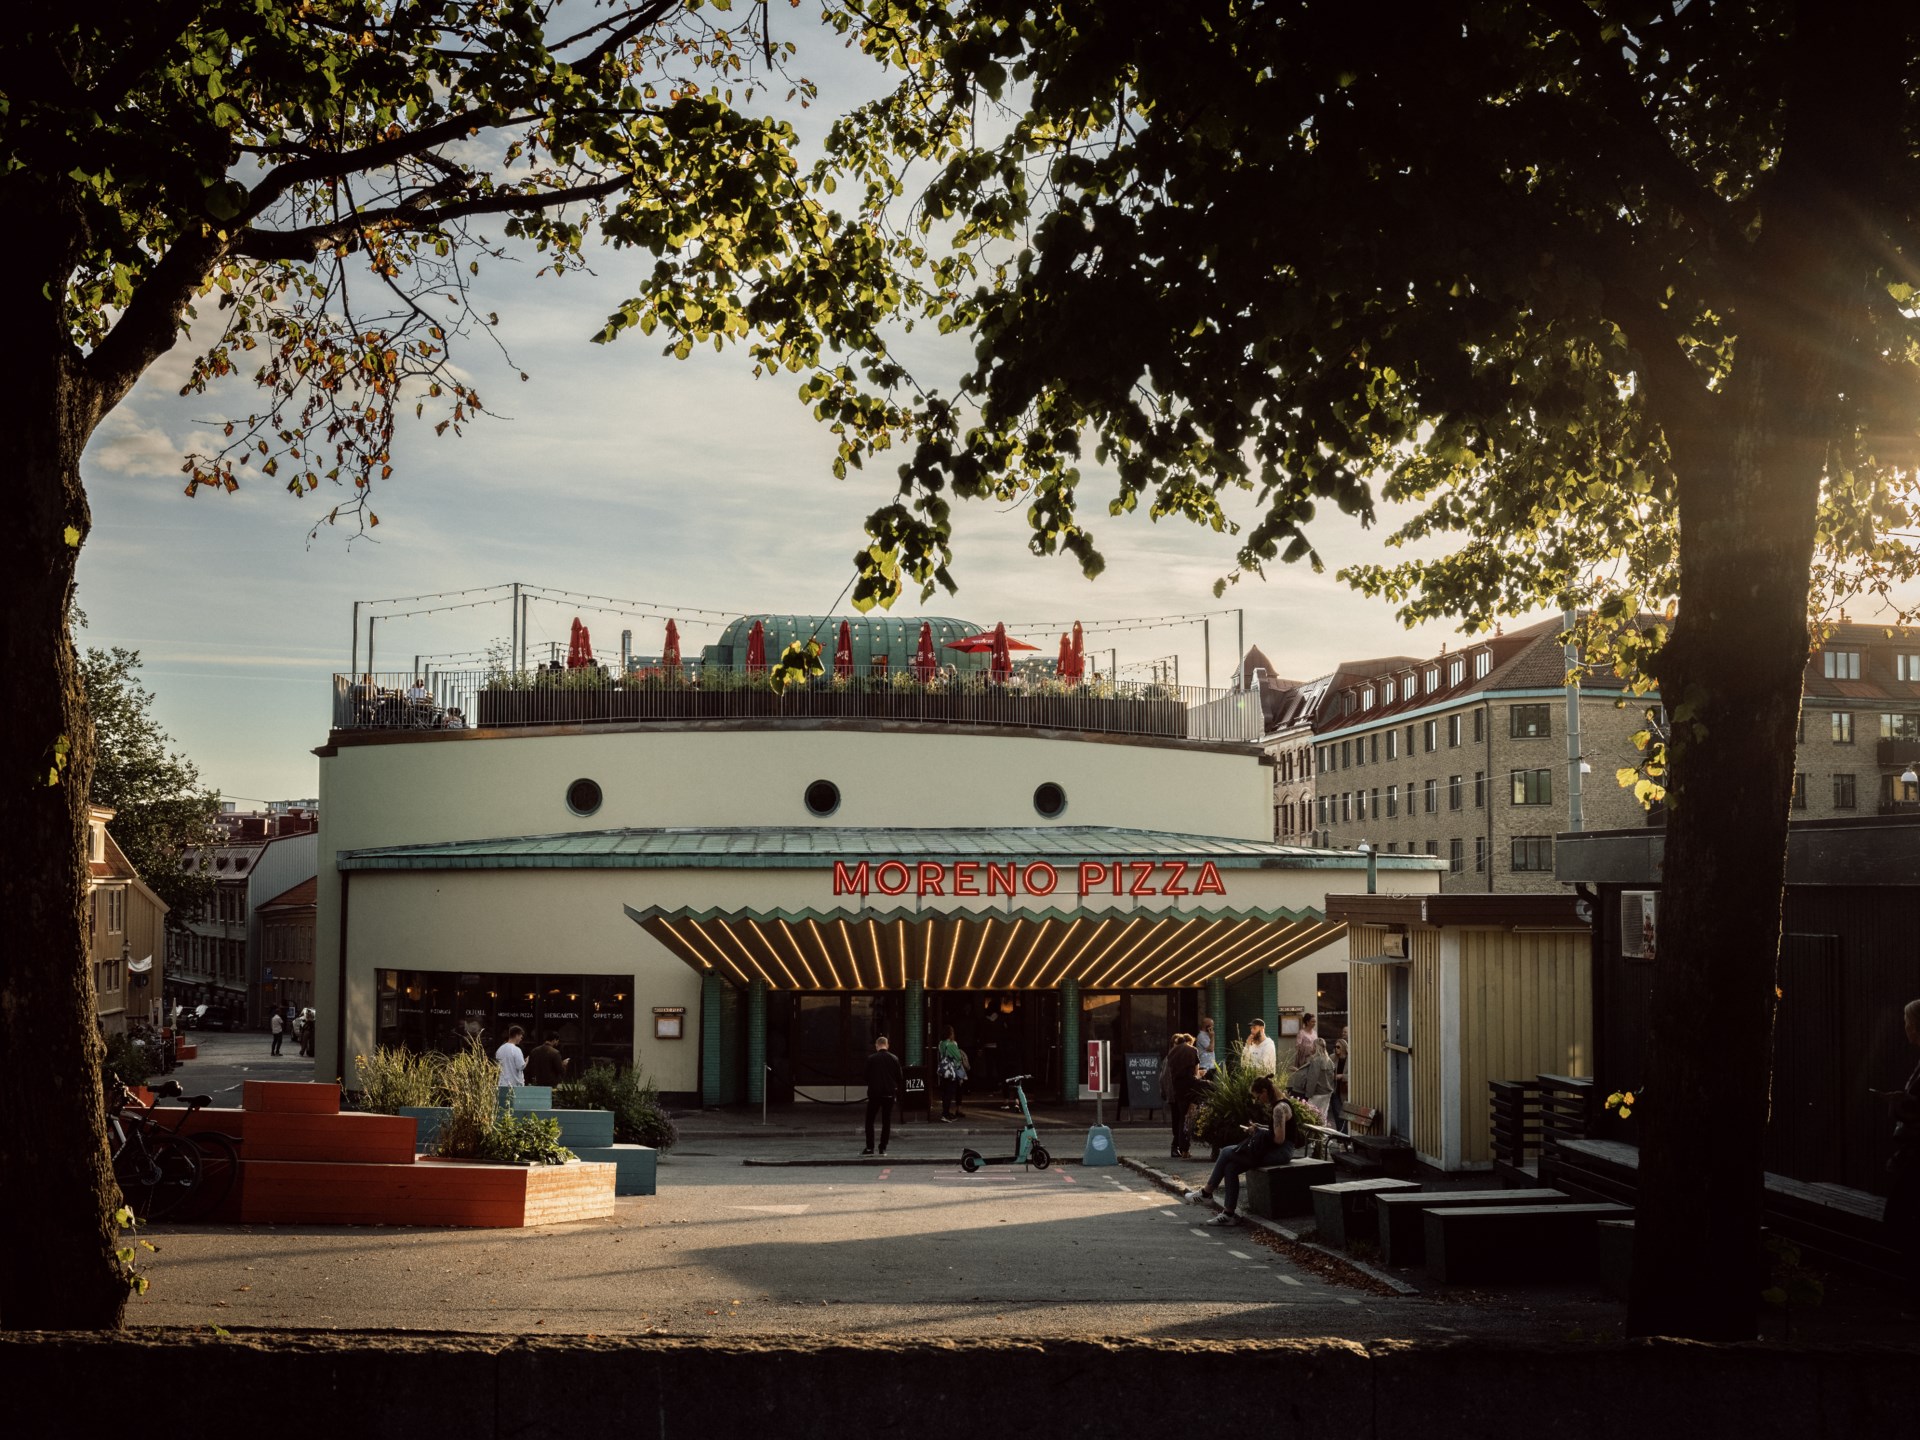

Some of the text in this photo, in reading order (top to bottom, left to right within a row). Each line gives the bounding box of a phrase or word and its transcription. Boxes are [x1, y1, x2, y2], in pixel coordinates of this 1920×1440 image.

[832, 860, 1227, 897] MORENO PIZZA
[905, 1078, 925, 1089] PIZZA
